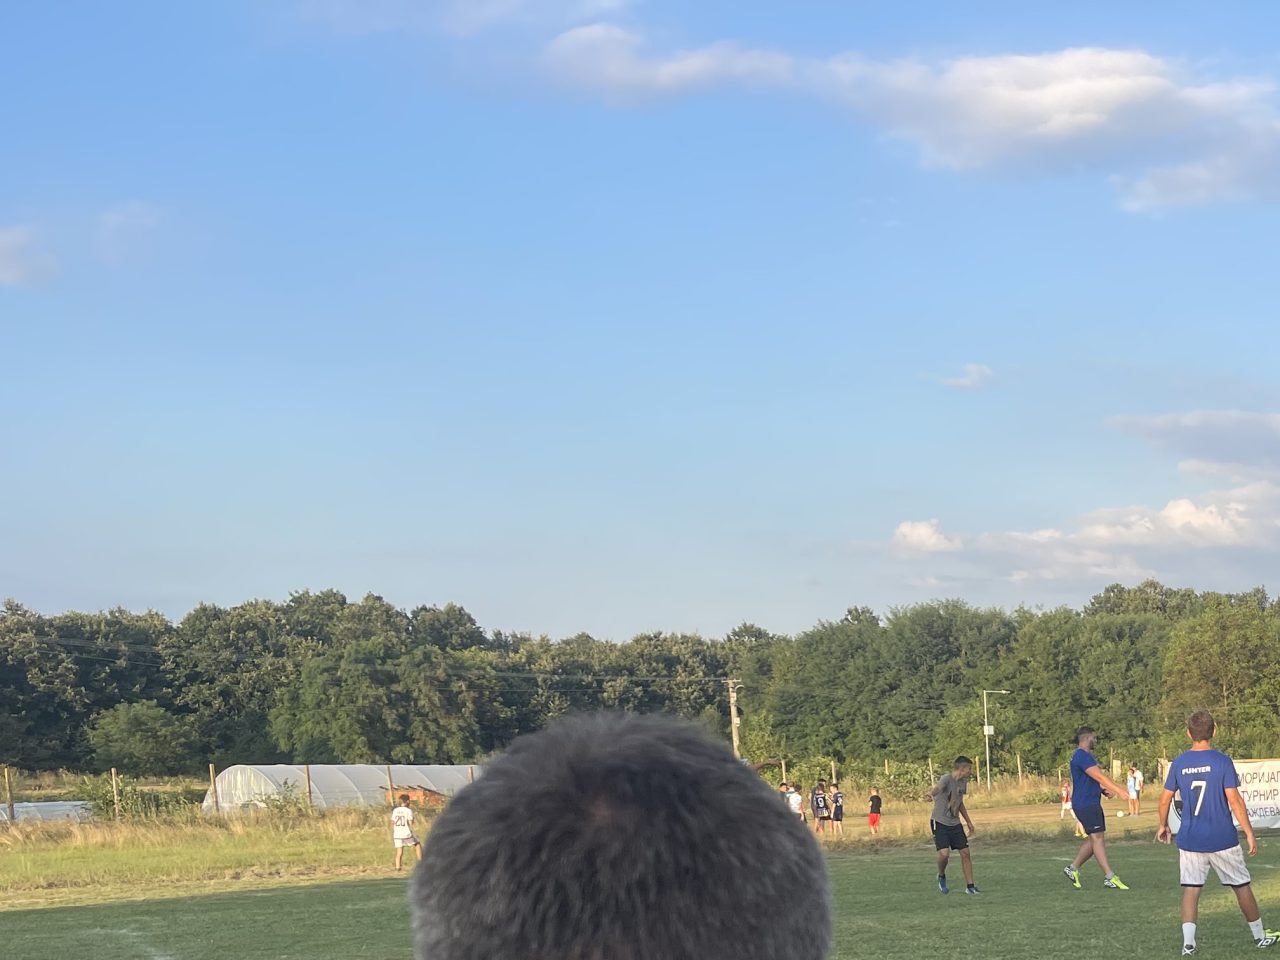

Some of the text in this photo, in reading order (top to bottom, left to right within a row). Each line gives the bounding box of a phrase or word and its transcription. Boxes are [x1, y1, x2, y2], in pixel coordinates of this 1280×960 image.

[1191, 780, 1207, 816] 7
[1241, 788, 1279, 802] ТУРНИР
[395, 815, 406, 827] 20
